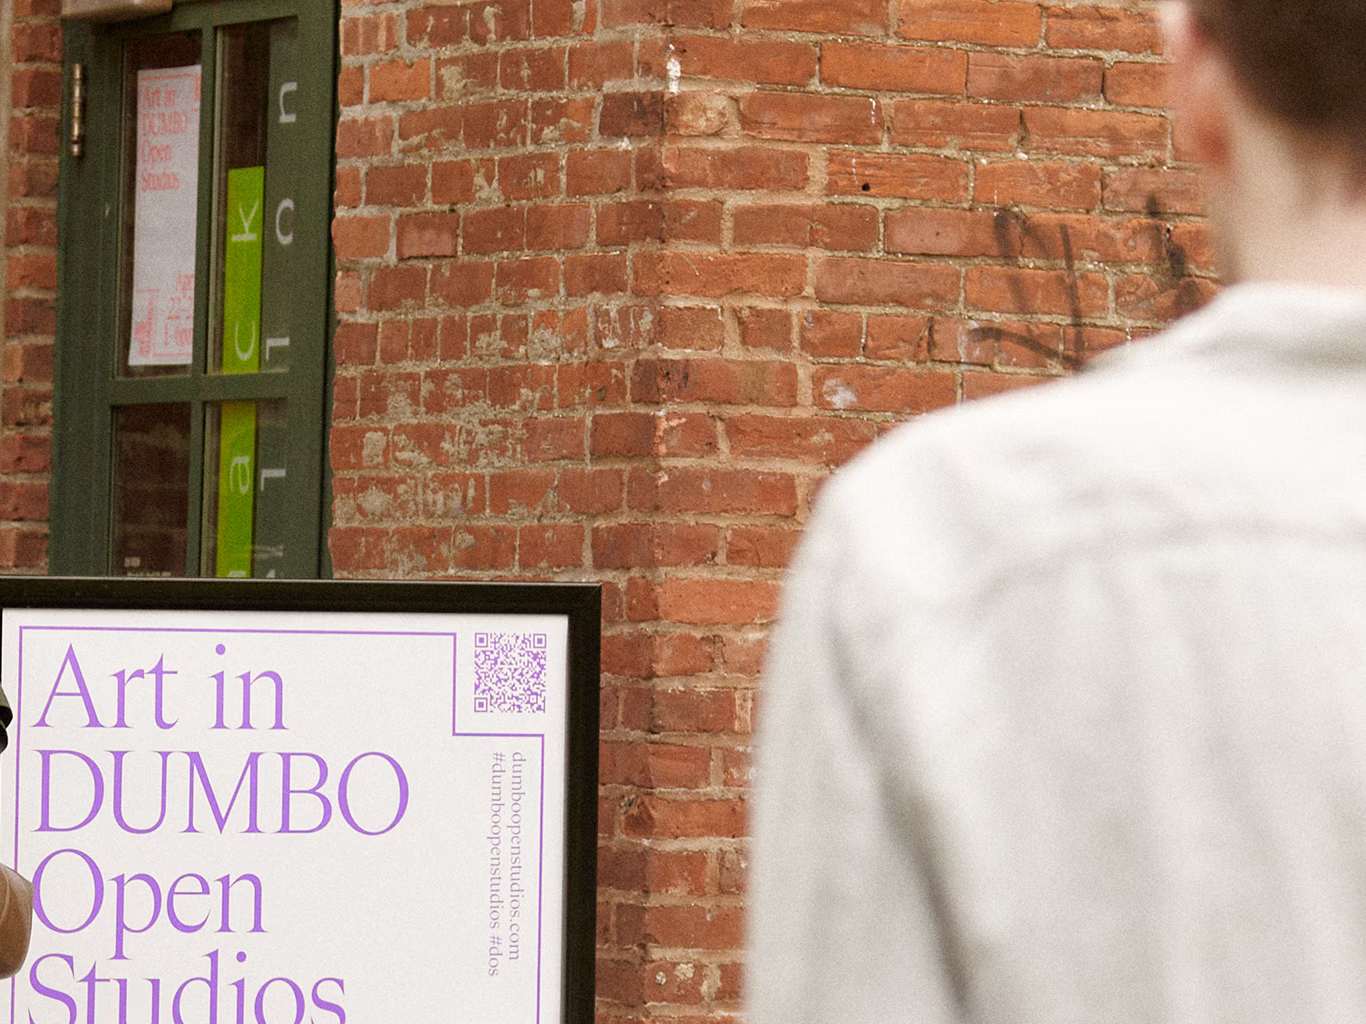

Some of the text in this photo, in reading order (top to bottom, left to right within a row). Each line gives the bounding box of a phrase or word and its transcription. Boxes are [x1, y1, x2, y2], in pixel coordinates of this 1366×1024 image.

[32, 643, 290, 731] Art in
[33, 749, 410, 837] DUMBO
[33, 848, 268, 961] Open
[487, 751, 507, 977] #dumboopenstudios #dos
[507, 751, 527, 961] dumboopenstudios.com
